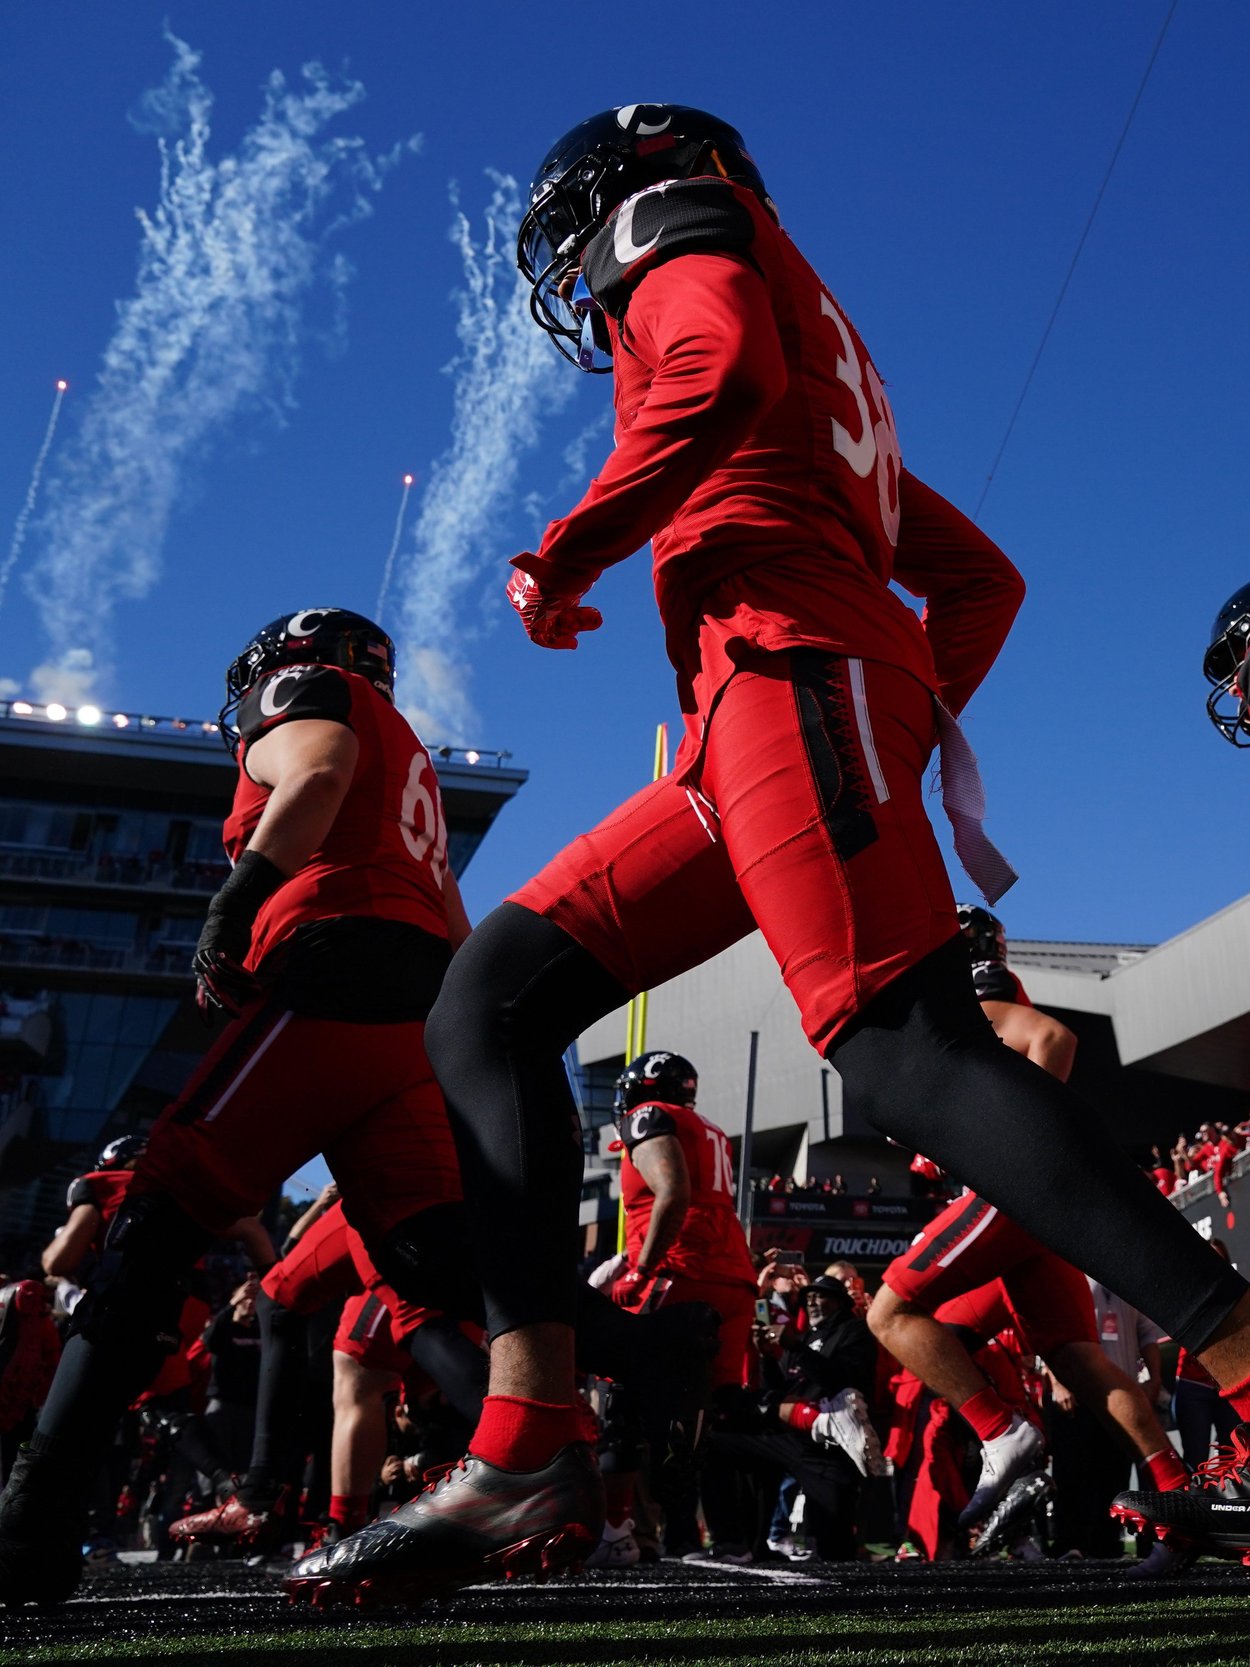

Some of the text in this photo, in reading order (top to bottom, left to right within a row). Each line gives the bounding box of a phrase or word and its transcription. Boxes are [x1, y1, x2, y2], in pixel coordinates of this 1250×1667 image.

[820, 291, 901, 547] 38
[788, 1201, 826, 1212] TOYOTA
[871, 1205, 909, 1216] TOYOTA
[1211, 1503, 1246, 1512] UNDER
